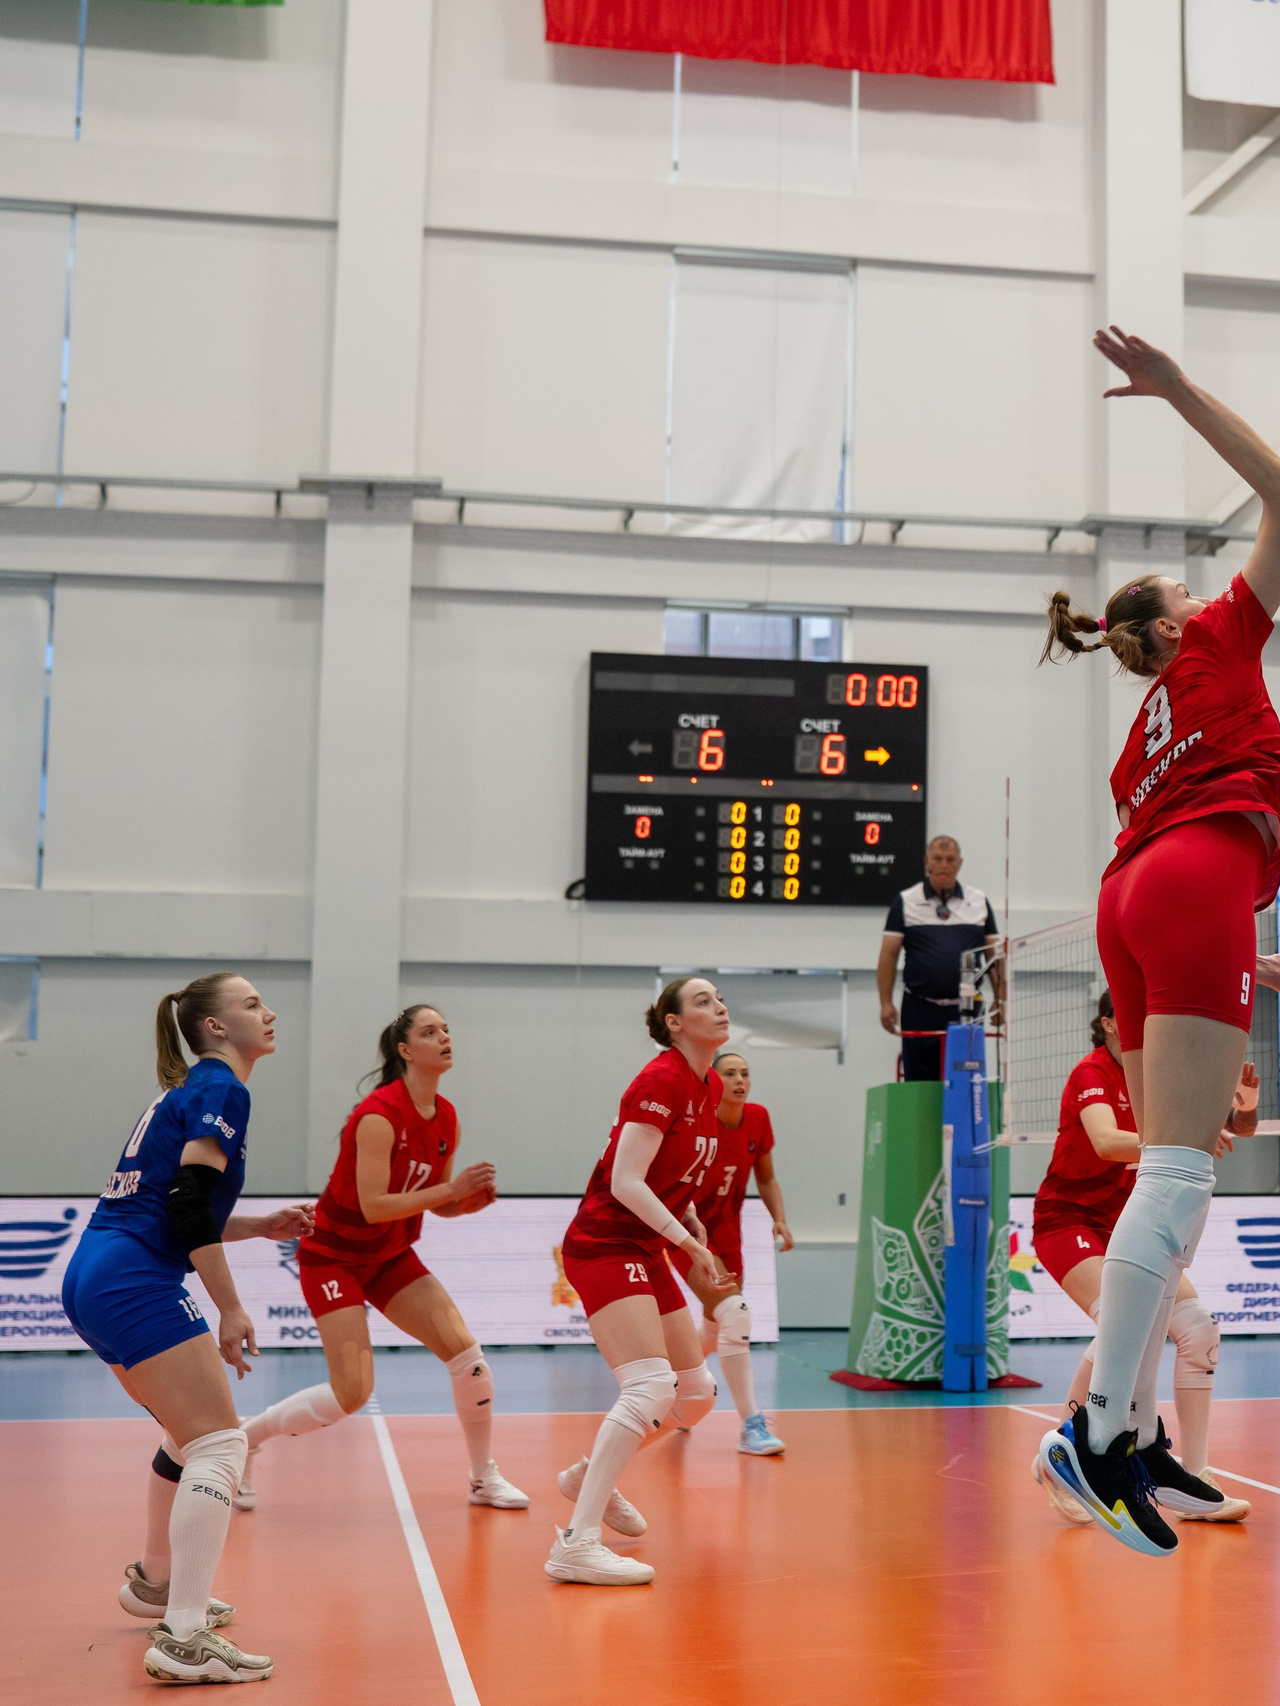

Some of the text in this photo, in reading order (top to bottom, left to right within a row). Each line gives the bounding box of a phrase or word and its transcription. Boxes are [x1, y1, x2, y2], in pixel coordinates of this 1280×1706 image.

[678, 714, 720, 729] СЧЕТ
[800, 719, 842, 733] СЧЕТ
[1143, 683, 1172, 760] 9
[698, 729, 725, 771] 6
[820, 733, 846, 775] 6
[730, 801, 800, 826] 0 1 0
[634, 815, 651, 839] 0
[730, 826, 800, 851] 0 2 0
[864, 822, 880, 845] 0
[729, 851, 800, 875] 0 3 0
[729, 876, 800, 900] 0 4 0
[1240, 971, 1251, 1006] 9
[716, 1165, 738, 1197] 3
[1076, 1234, 1091, 1249] 4
[624, 1262, 649, 1283] 29
[321, 1279, 343, 1301] 12
